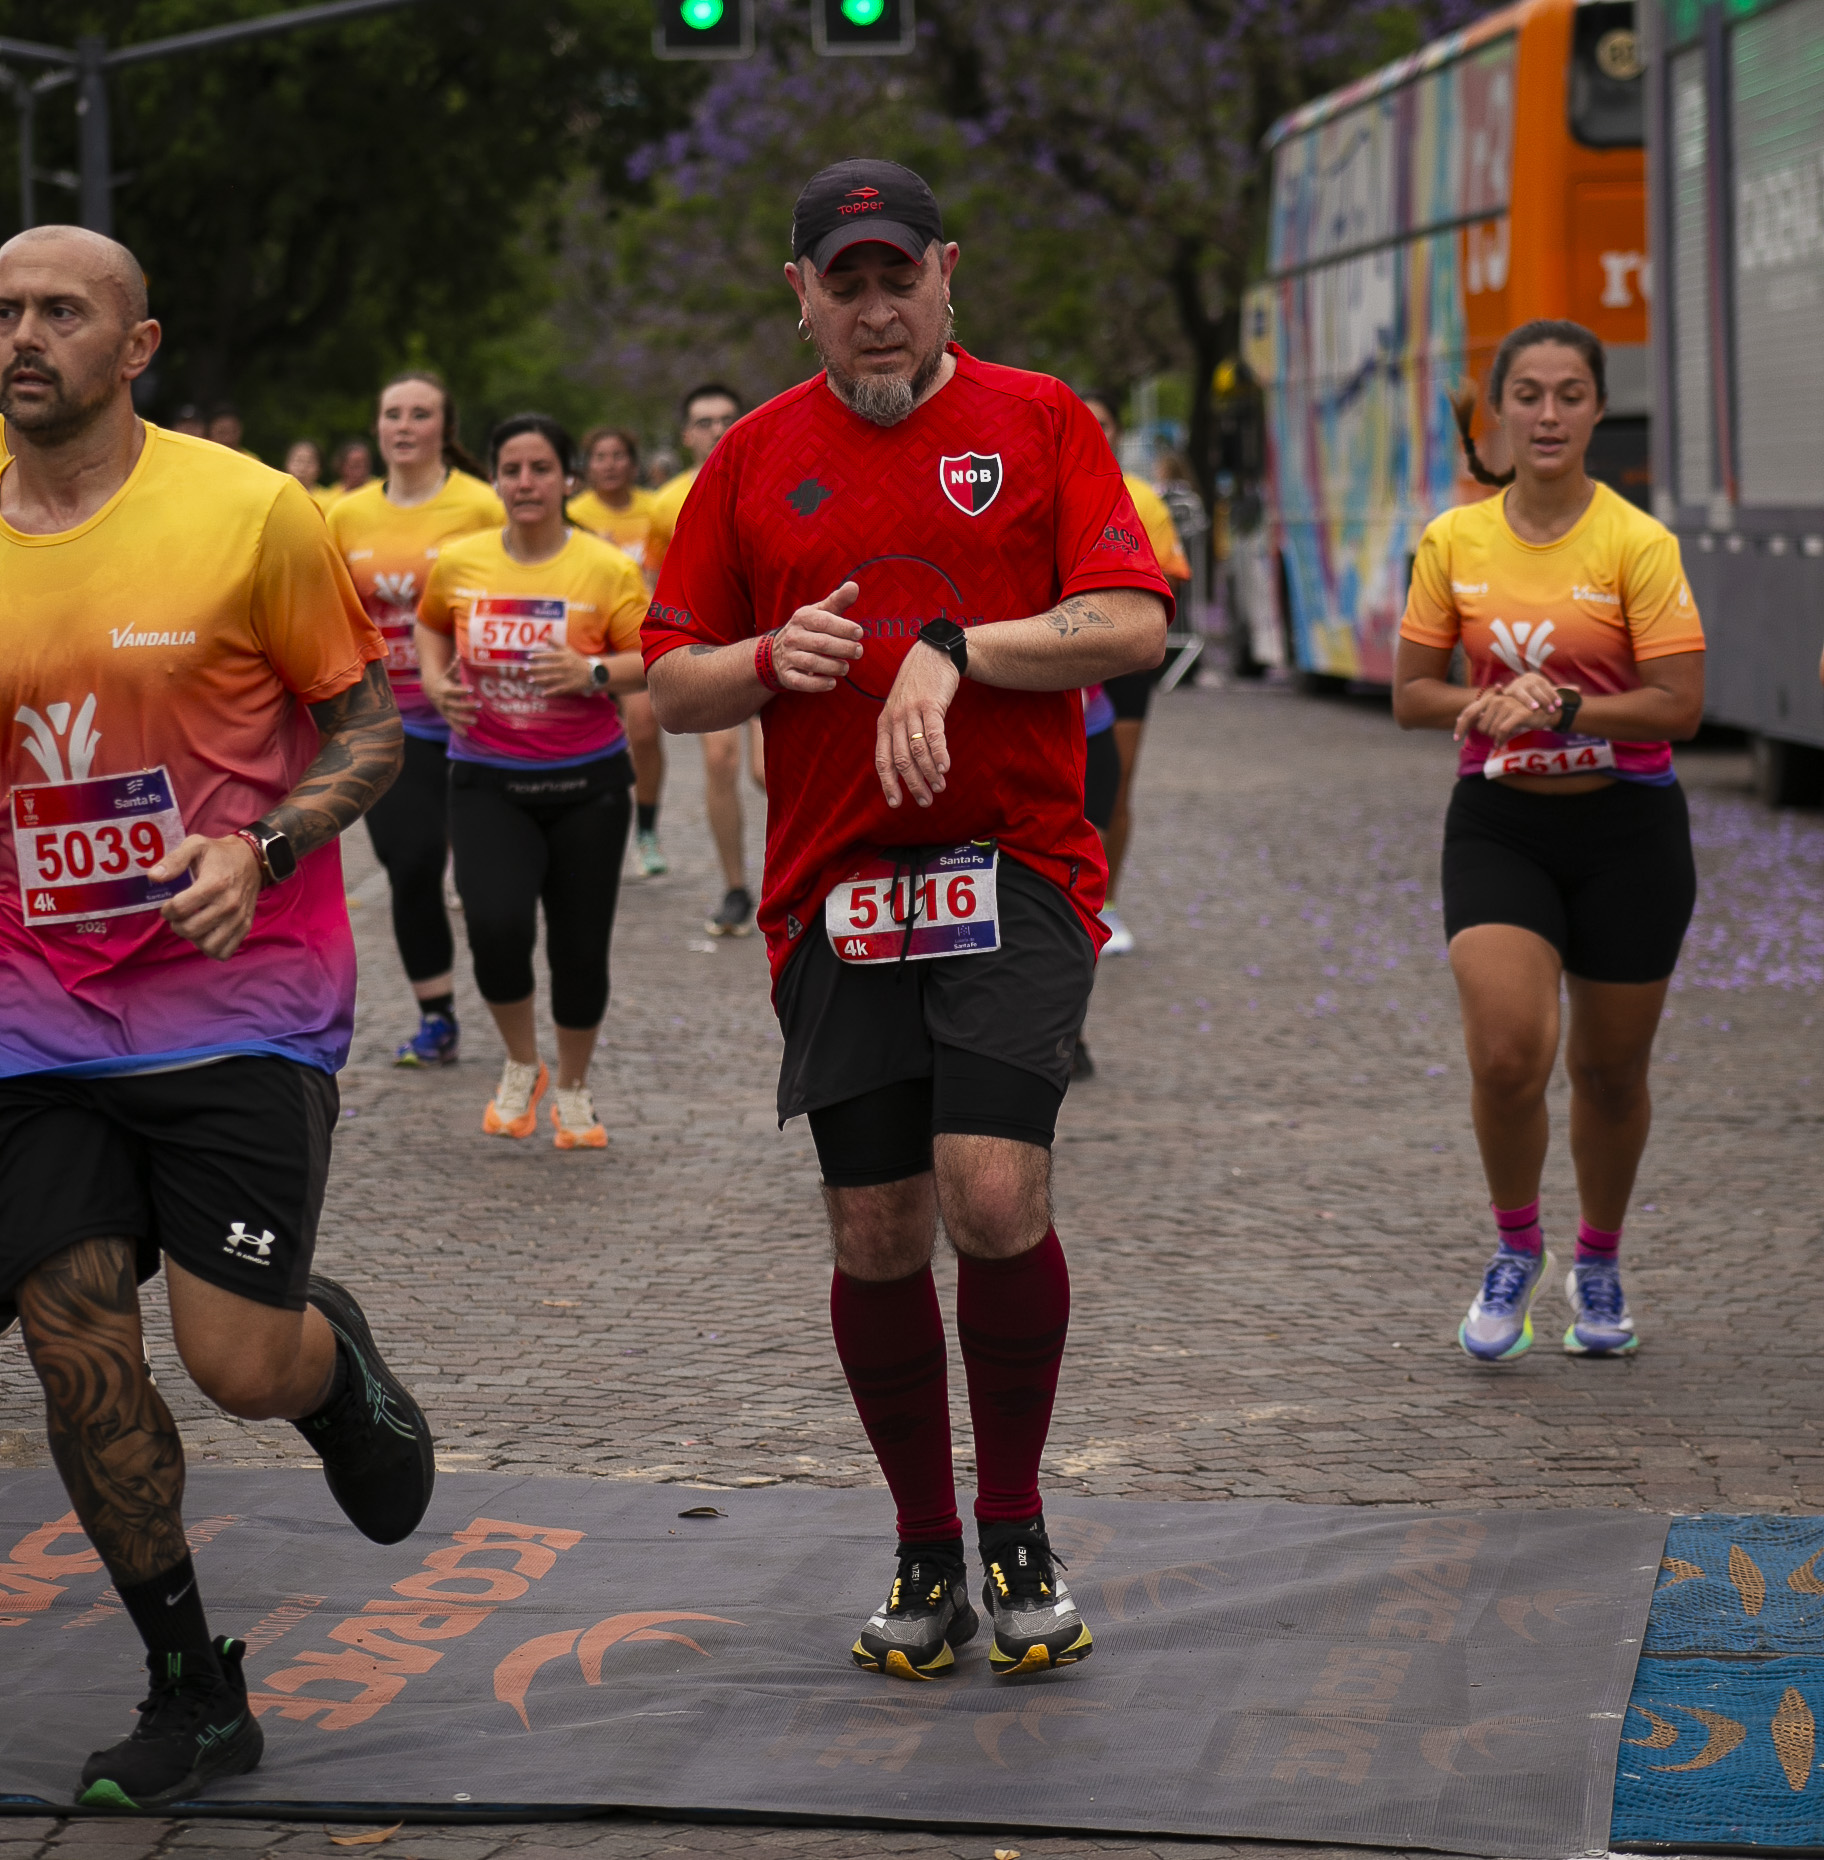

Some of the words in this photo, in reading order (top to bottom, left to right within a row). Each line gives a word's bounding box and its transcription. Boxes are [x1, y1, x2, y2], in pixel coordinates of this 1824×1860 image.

[951, 469, 992, 484] NOB
[108, 621, 196, 649] VANDALIA
[482, 619, 554, 646] 5704
[114, 796, 148, 809] Santa
[149, 794, 161, 804] Fe
[35, 821, 165, 882] 5039
[940, 856, 970, 866] Santa
[972, 855, 985, 864] Fe
[33, 892, 57, 912] 4k
[848, 875, 977, 930] 5116
[844, 939, 869, 956] 4k
